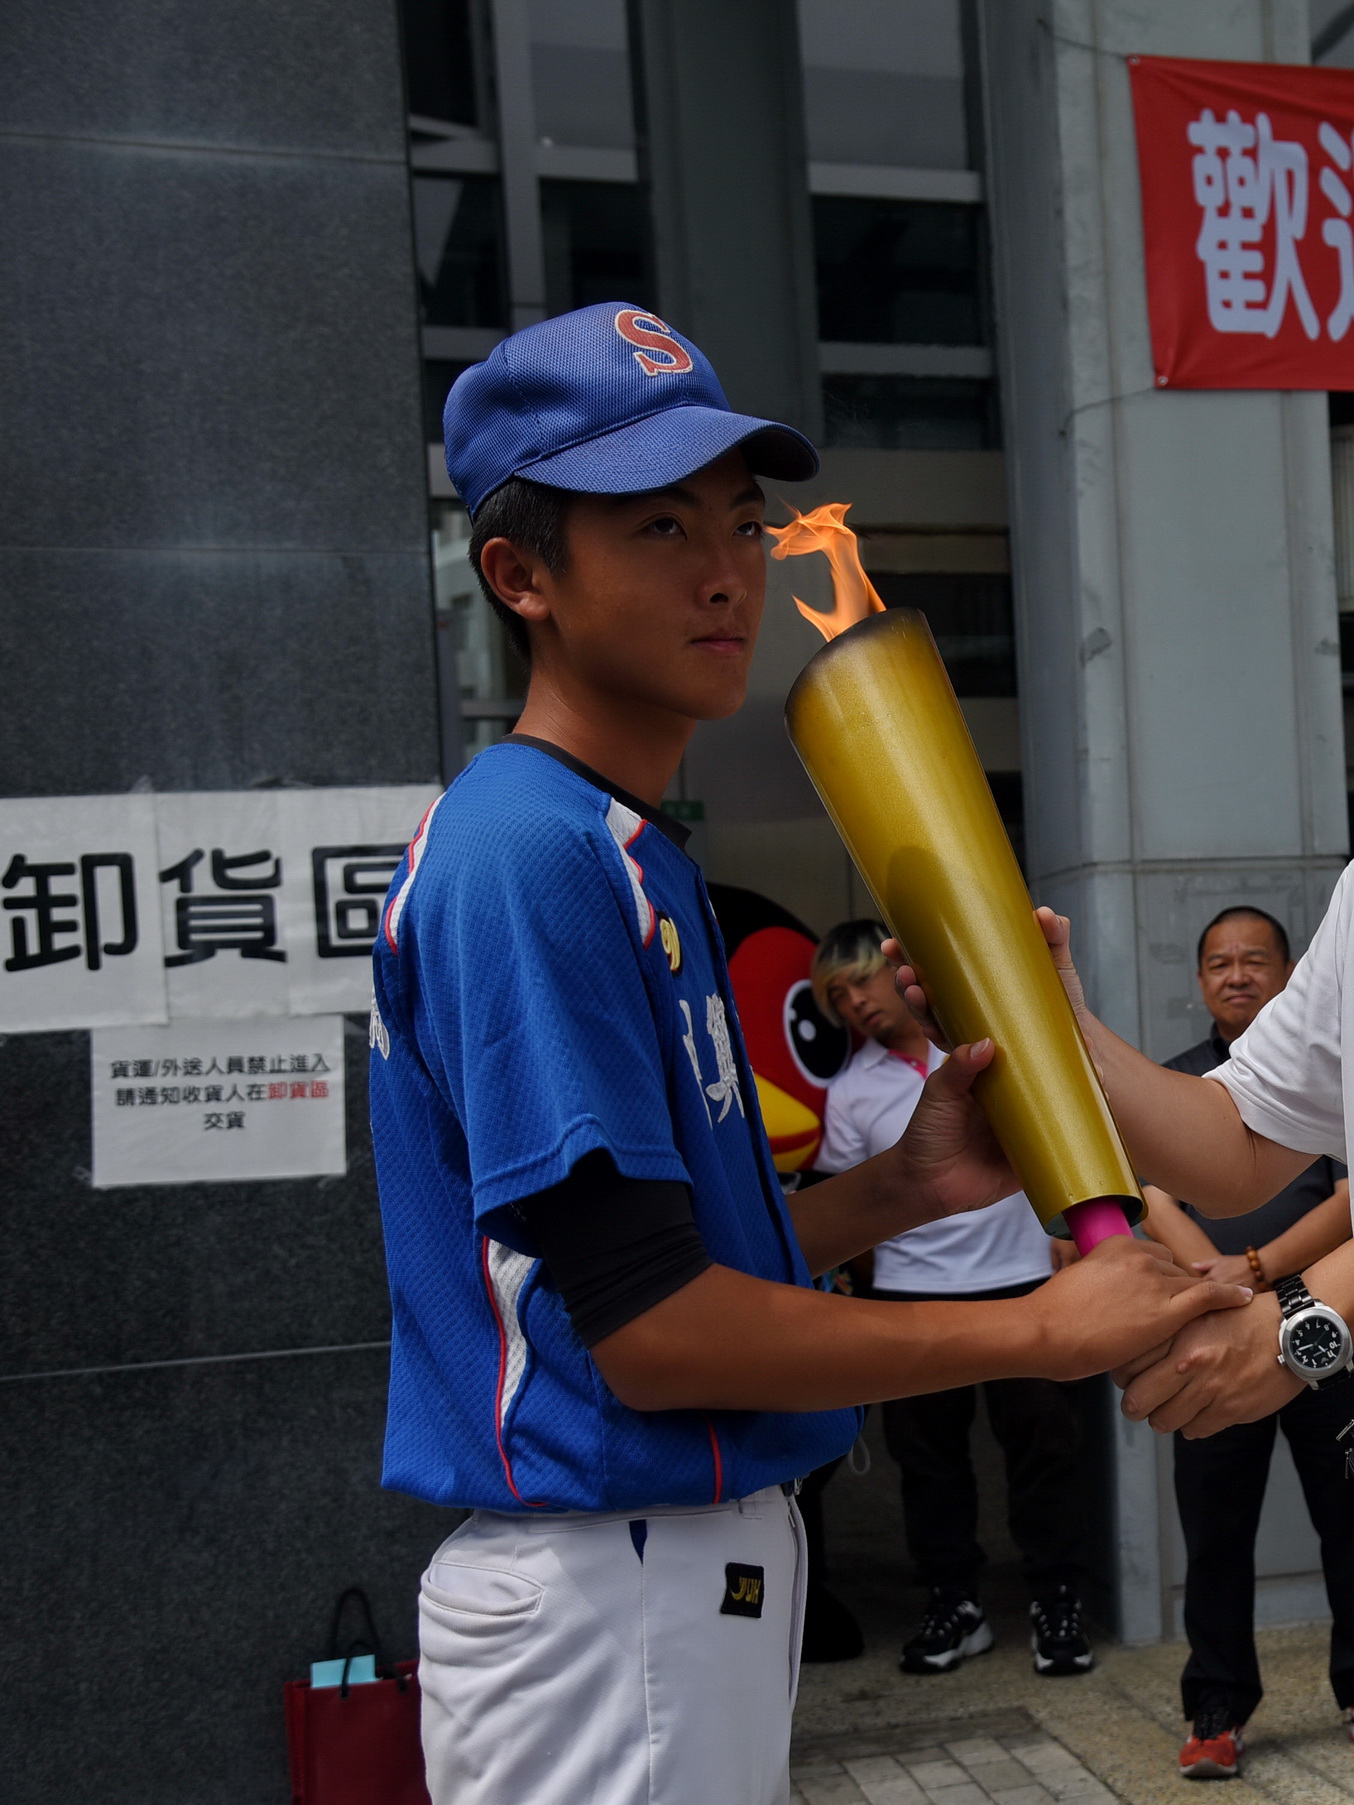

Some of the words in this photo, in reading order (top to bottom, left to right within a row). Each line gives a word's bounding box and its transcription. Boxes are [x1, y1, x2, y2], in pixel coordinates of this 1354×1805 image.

[615, 309, 693, 376] S
[2, 842, 415, 972] 卸貨區
[659, 916, 682, 973] 9
[111, 1053, 331, 1079] 貨運/外送人員禁止進入
[115, 1080, 329, 1106] 請通知收貨人在卸貨區
[203, 1111, 246, 1130] 交貨
